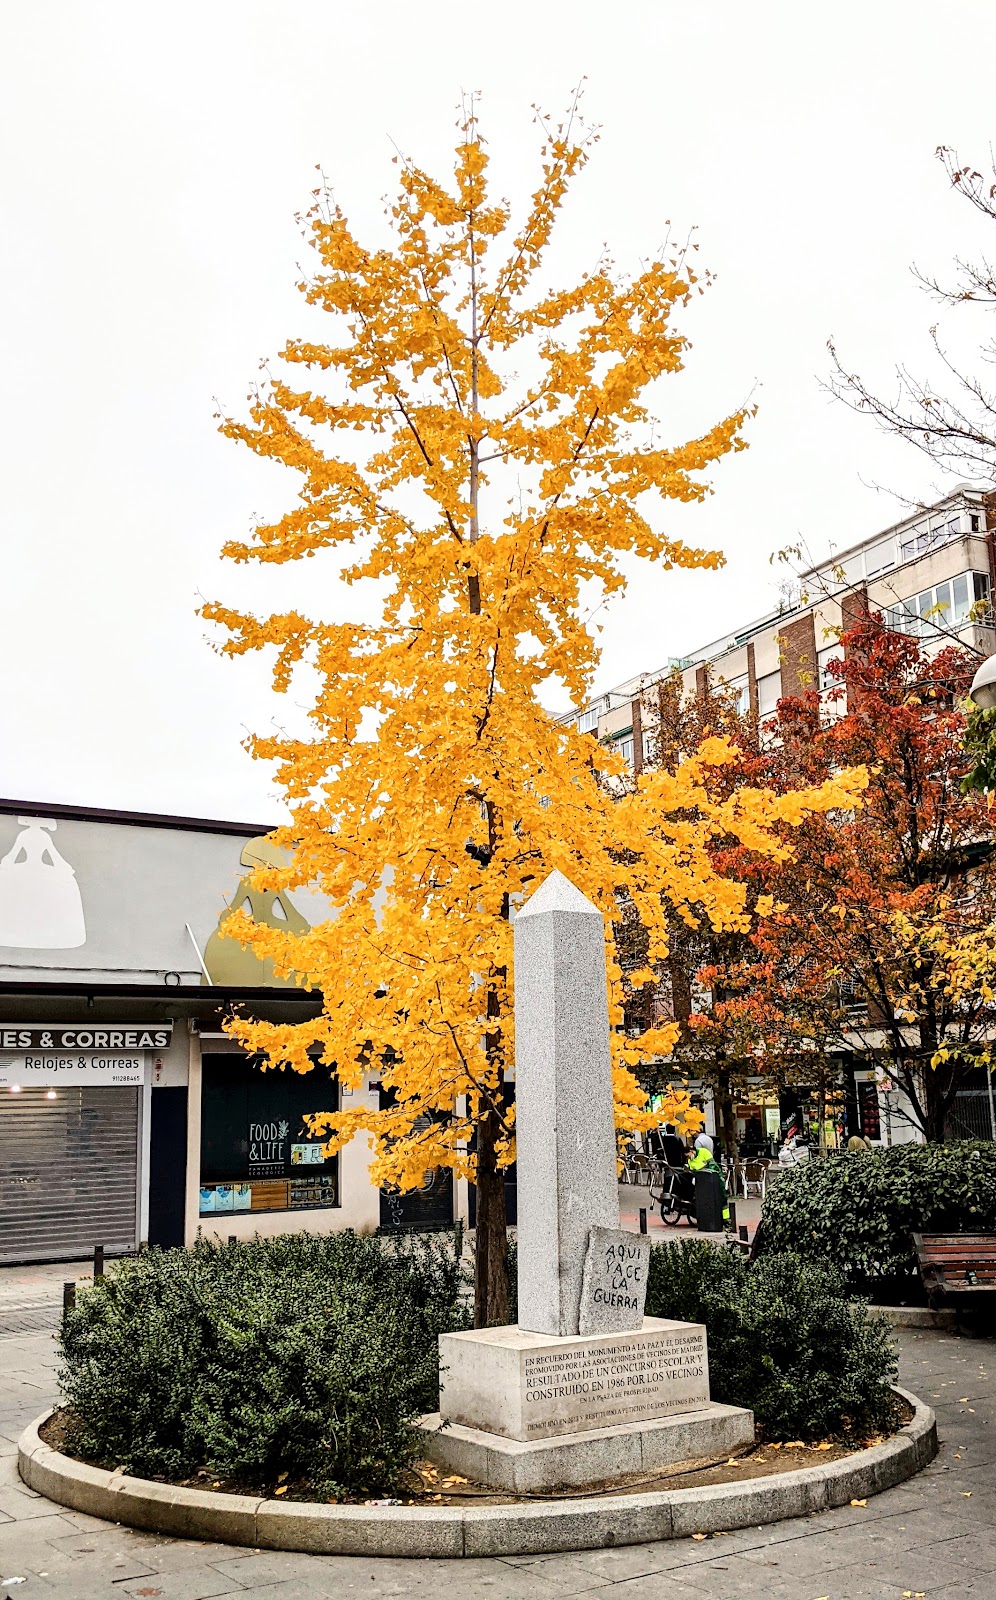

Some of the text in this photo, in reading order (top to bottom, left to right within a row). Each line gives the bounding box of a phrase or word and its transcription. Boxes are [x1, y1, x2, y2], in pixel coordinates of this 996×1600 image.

[0, 1031, 168, 1048] ES & CORREAS
[24, 1056, 139, 1071] Relojes & Correas
[249, 1123, 278, 1141] FOOD
[605, 1245, 641, 1262] AQUI
[606, 1259, 641, 1281] YACE
[612, 1276, 628, 1291] LA
[593, 1288, 638, 1310] GUERRA
[525, 1358, 535, 1366] EN
[536, 1352, 573, 1365] RECUERDO
[573, 1351, 586, 1359] DEL
[588, 1345, 631, 1356] MONUMENTO
[647, 1341, 660, 1349] PAZ
[666, 1339, 674, 1347] EL
[674, 1335, 703, 1346] DESARME
[525, 1344, 704, 1376] PROMOVIDO POR LAS ASOCIACIONES DE VECINOS DE MADRID
[526, 1354, 703, 1388] RESULTADO DE UN CONCURSO ESCOLAR Y
[526, 1366, 704, 1402] CONSTRUIDO EN 1986 POR LOS VECINOS
[623, 1386, 659, 1397] PROSPERIDAD
